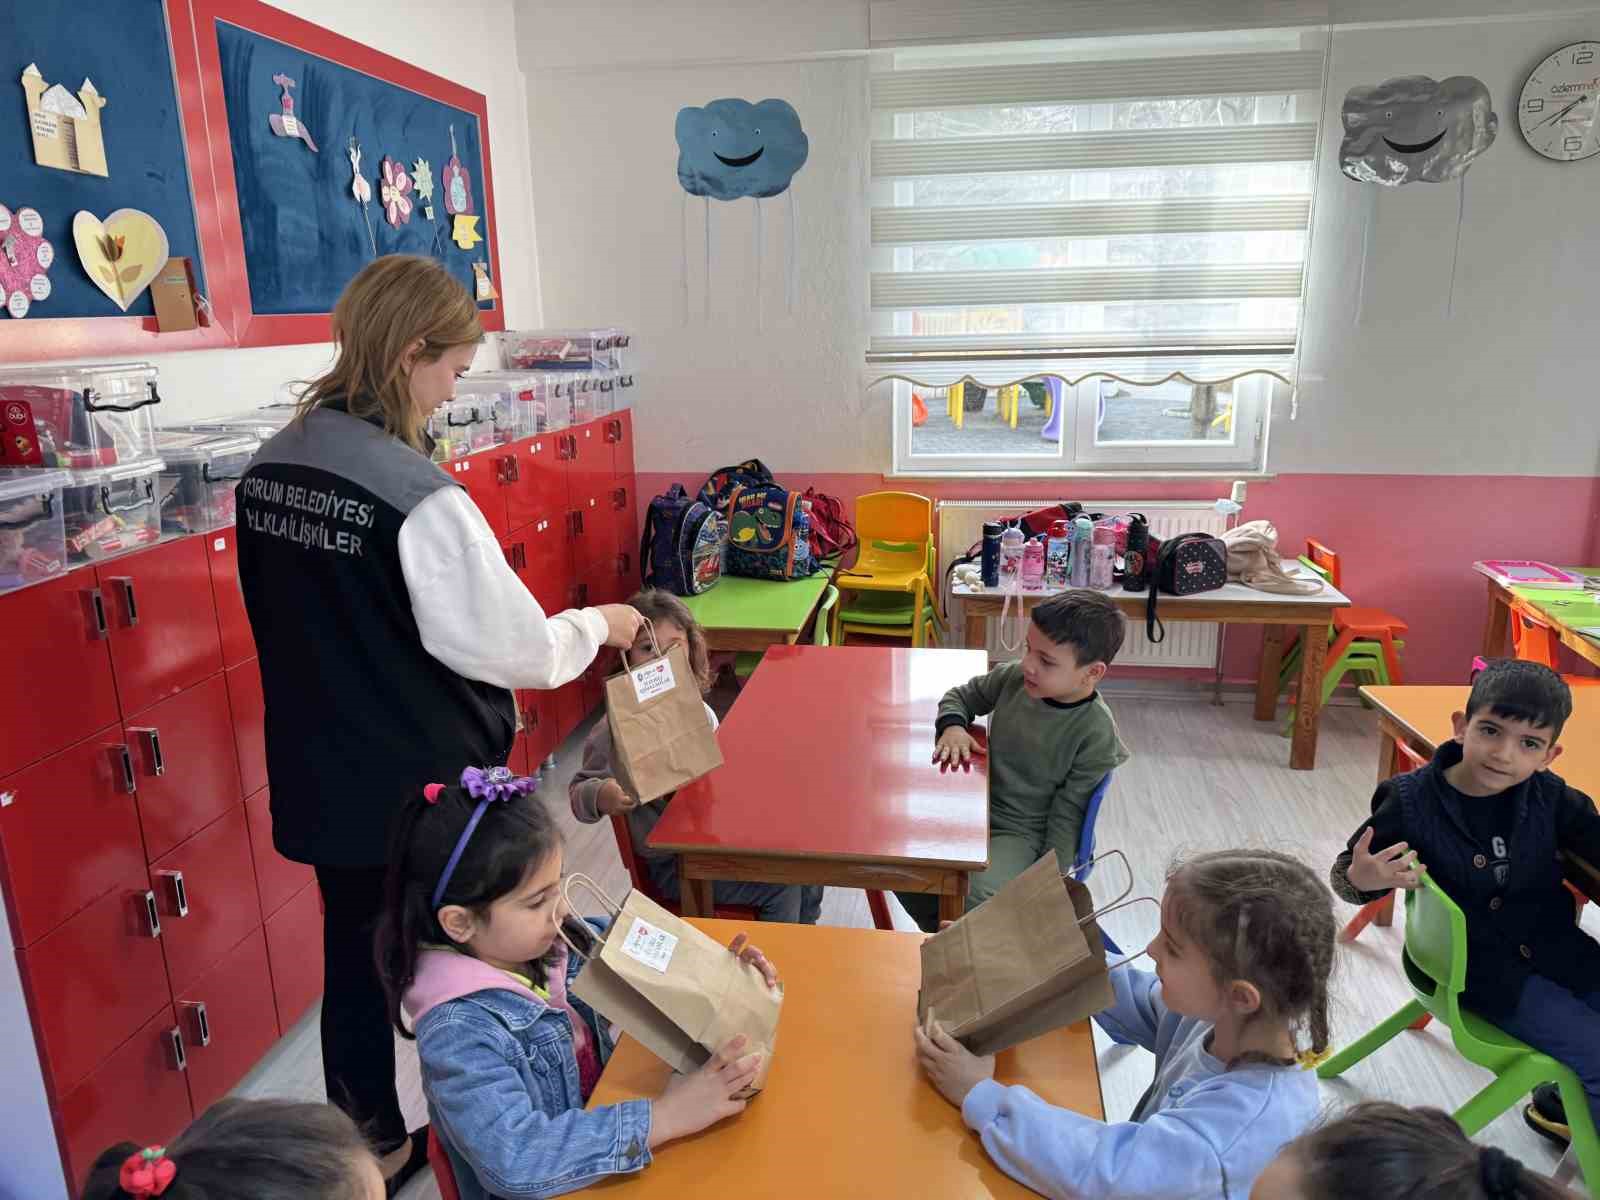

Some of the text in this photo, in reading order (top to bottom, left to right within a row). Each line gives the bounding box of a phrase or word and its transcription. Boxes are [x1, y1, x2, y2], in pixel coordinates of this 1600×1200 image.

[1571, 51, 1594, 65] 12
[1527, 98, 1544, 113] 9
[1563, 136, 1582, 152] 6
[285, 485, 376, 529] BELEDİYESİ
